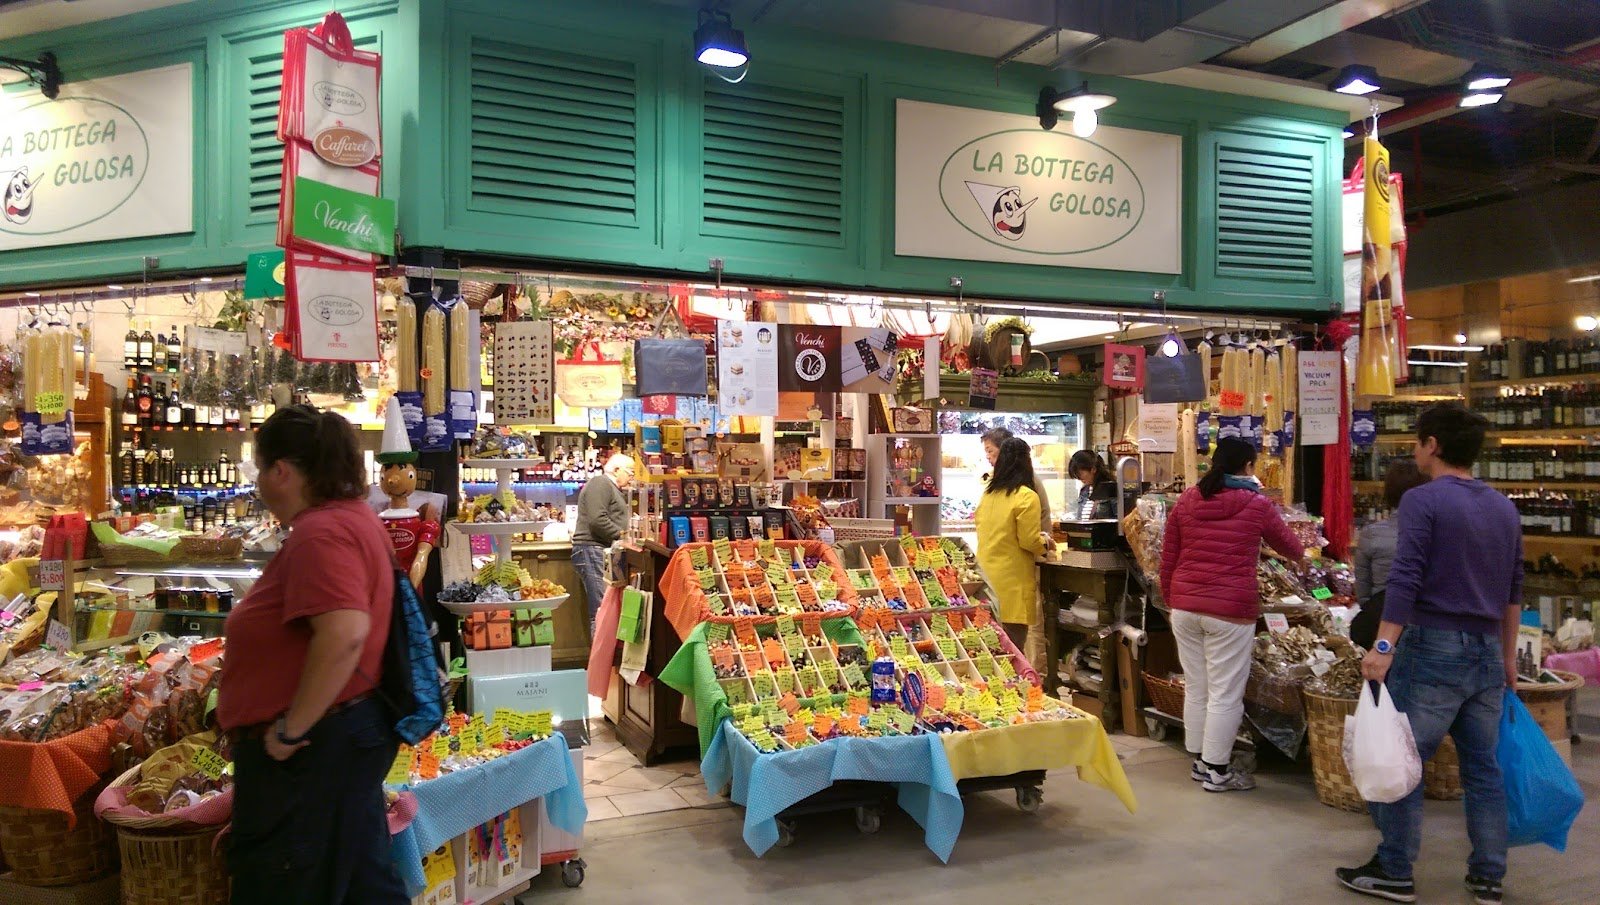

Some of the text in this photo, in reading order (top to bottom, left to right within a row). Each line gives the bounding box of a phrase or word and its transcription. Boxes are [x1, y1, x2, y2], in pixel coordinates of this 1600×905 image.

[1, 119, 116, 159] A BOTTEGA
[54, 154, 134, 187] GOLOSA
[972, 149, 1115, 185] LA BOTTEGA
[314, 200, 375, 237] Venchi
[1049, 191, 1131, 219] GOLOSA
[795, 332, 826, 346] Venchi
[516, 688, 548, 696] MAJANI
